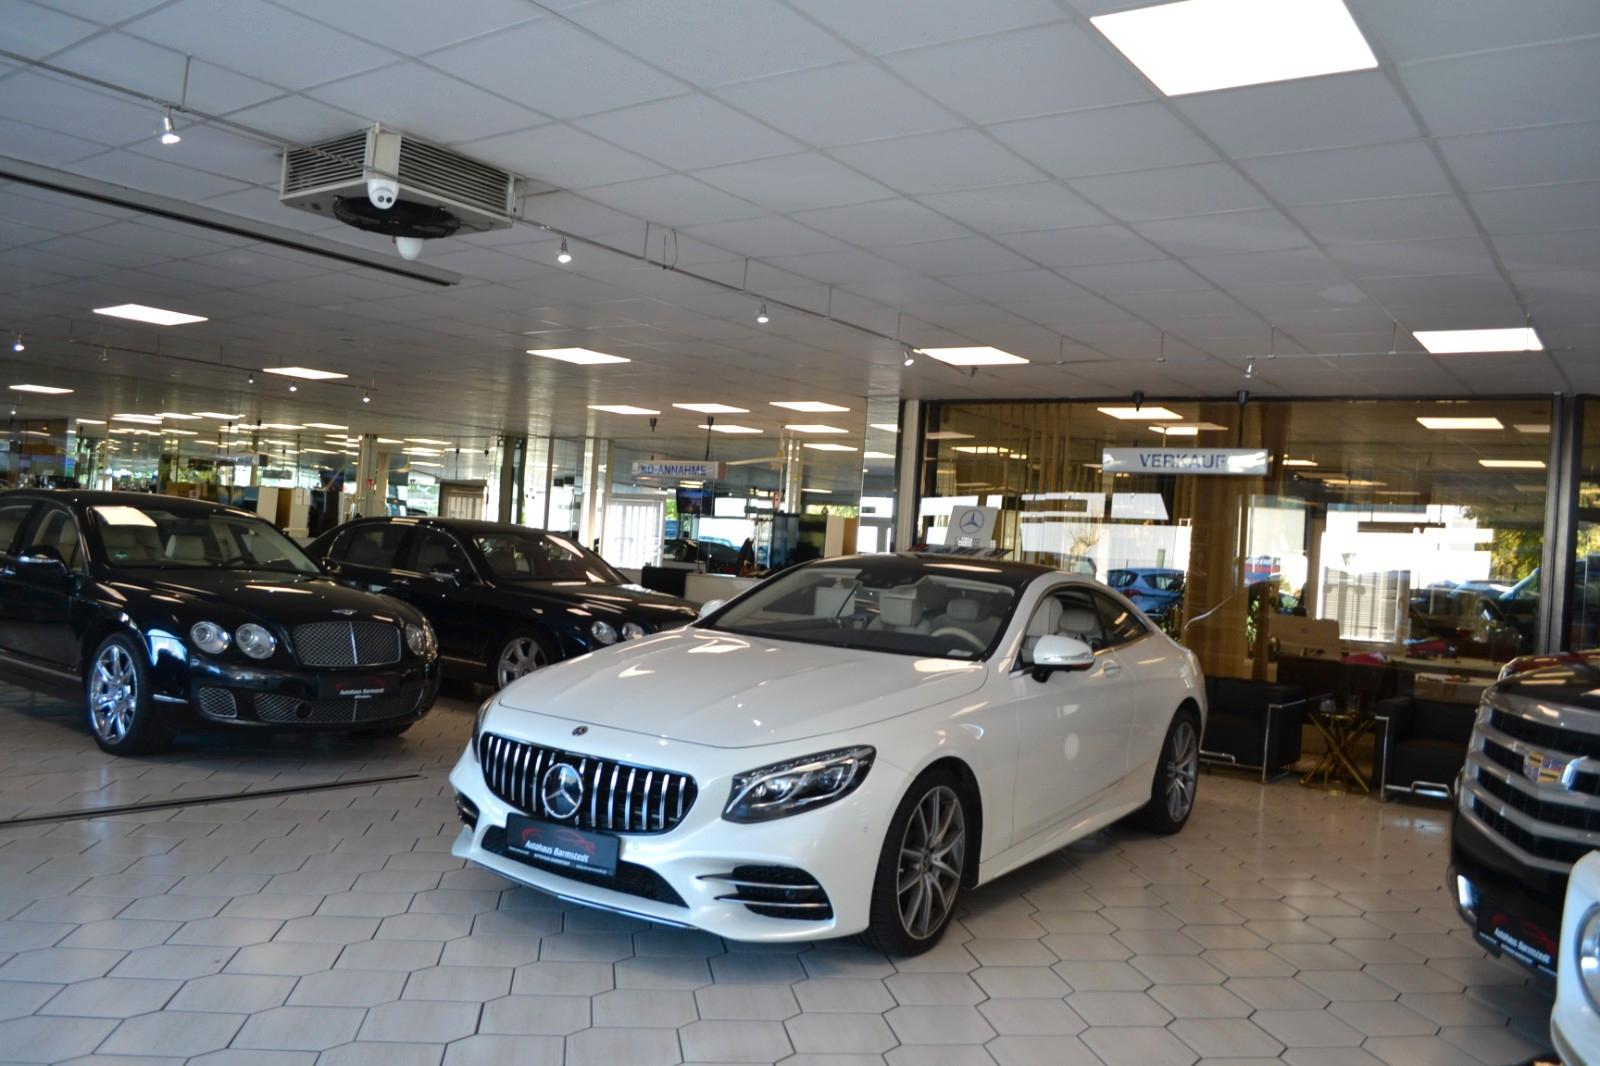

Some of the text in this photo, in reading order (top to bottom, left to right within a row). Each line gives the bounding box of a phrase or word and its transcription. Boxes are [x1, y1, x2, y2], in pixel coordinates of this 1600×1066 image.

[1140, 453, 1227, 469] VERKAUF
[524, 839, 553, 855] Autohaus
[553, 847, 590, 863] Barmstedt
